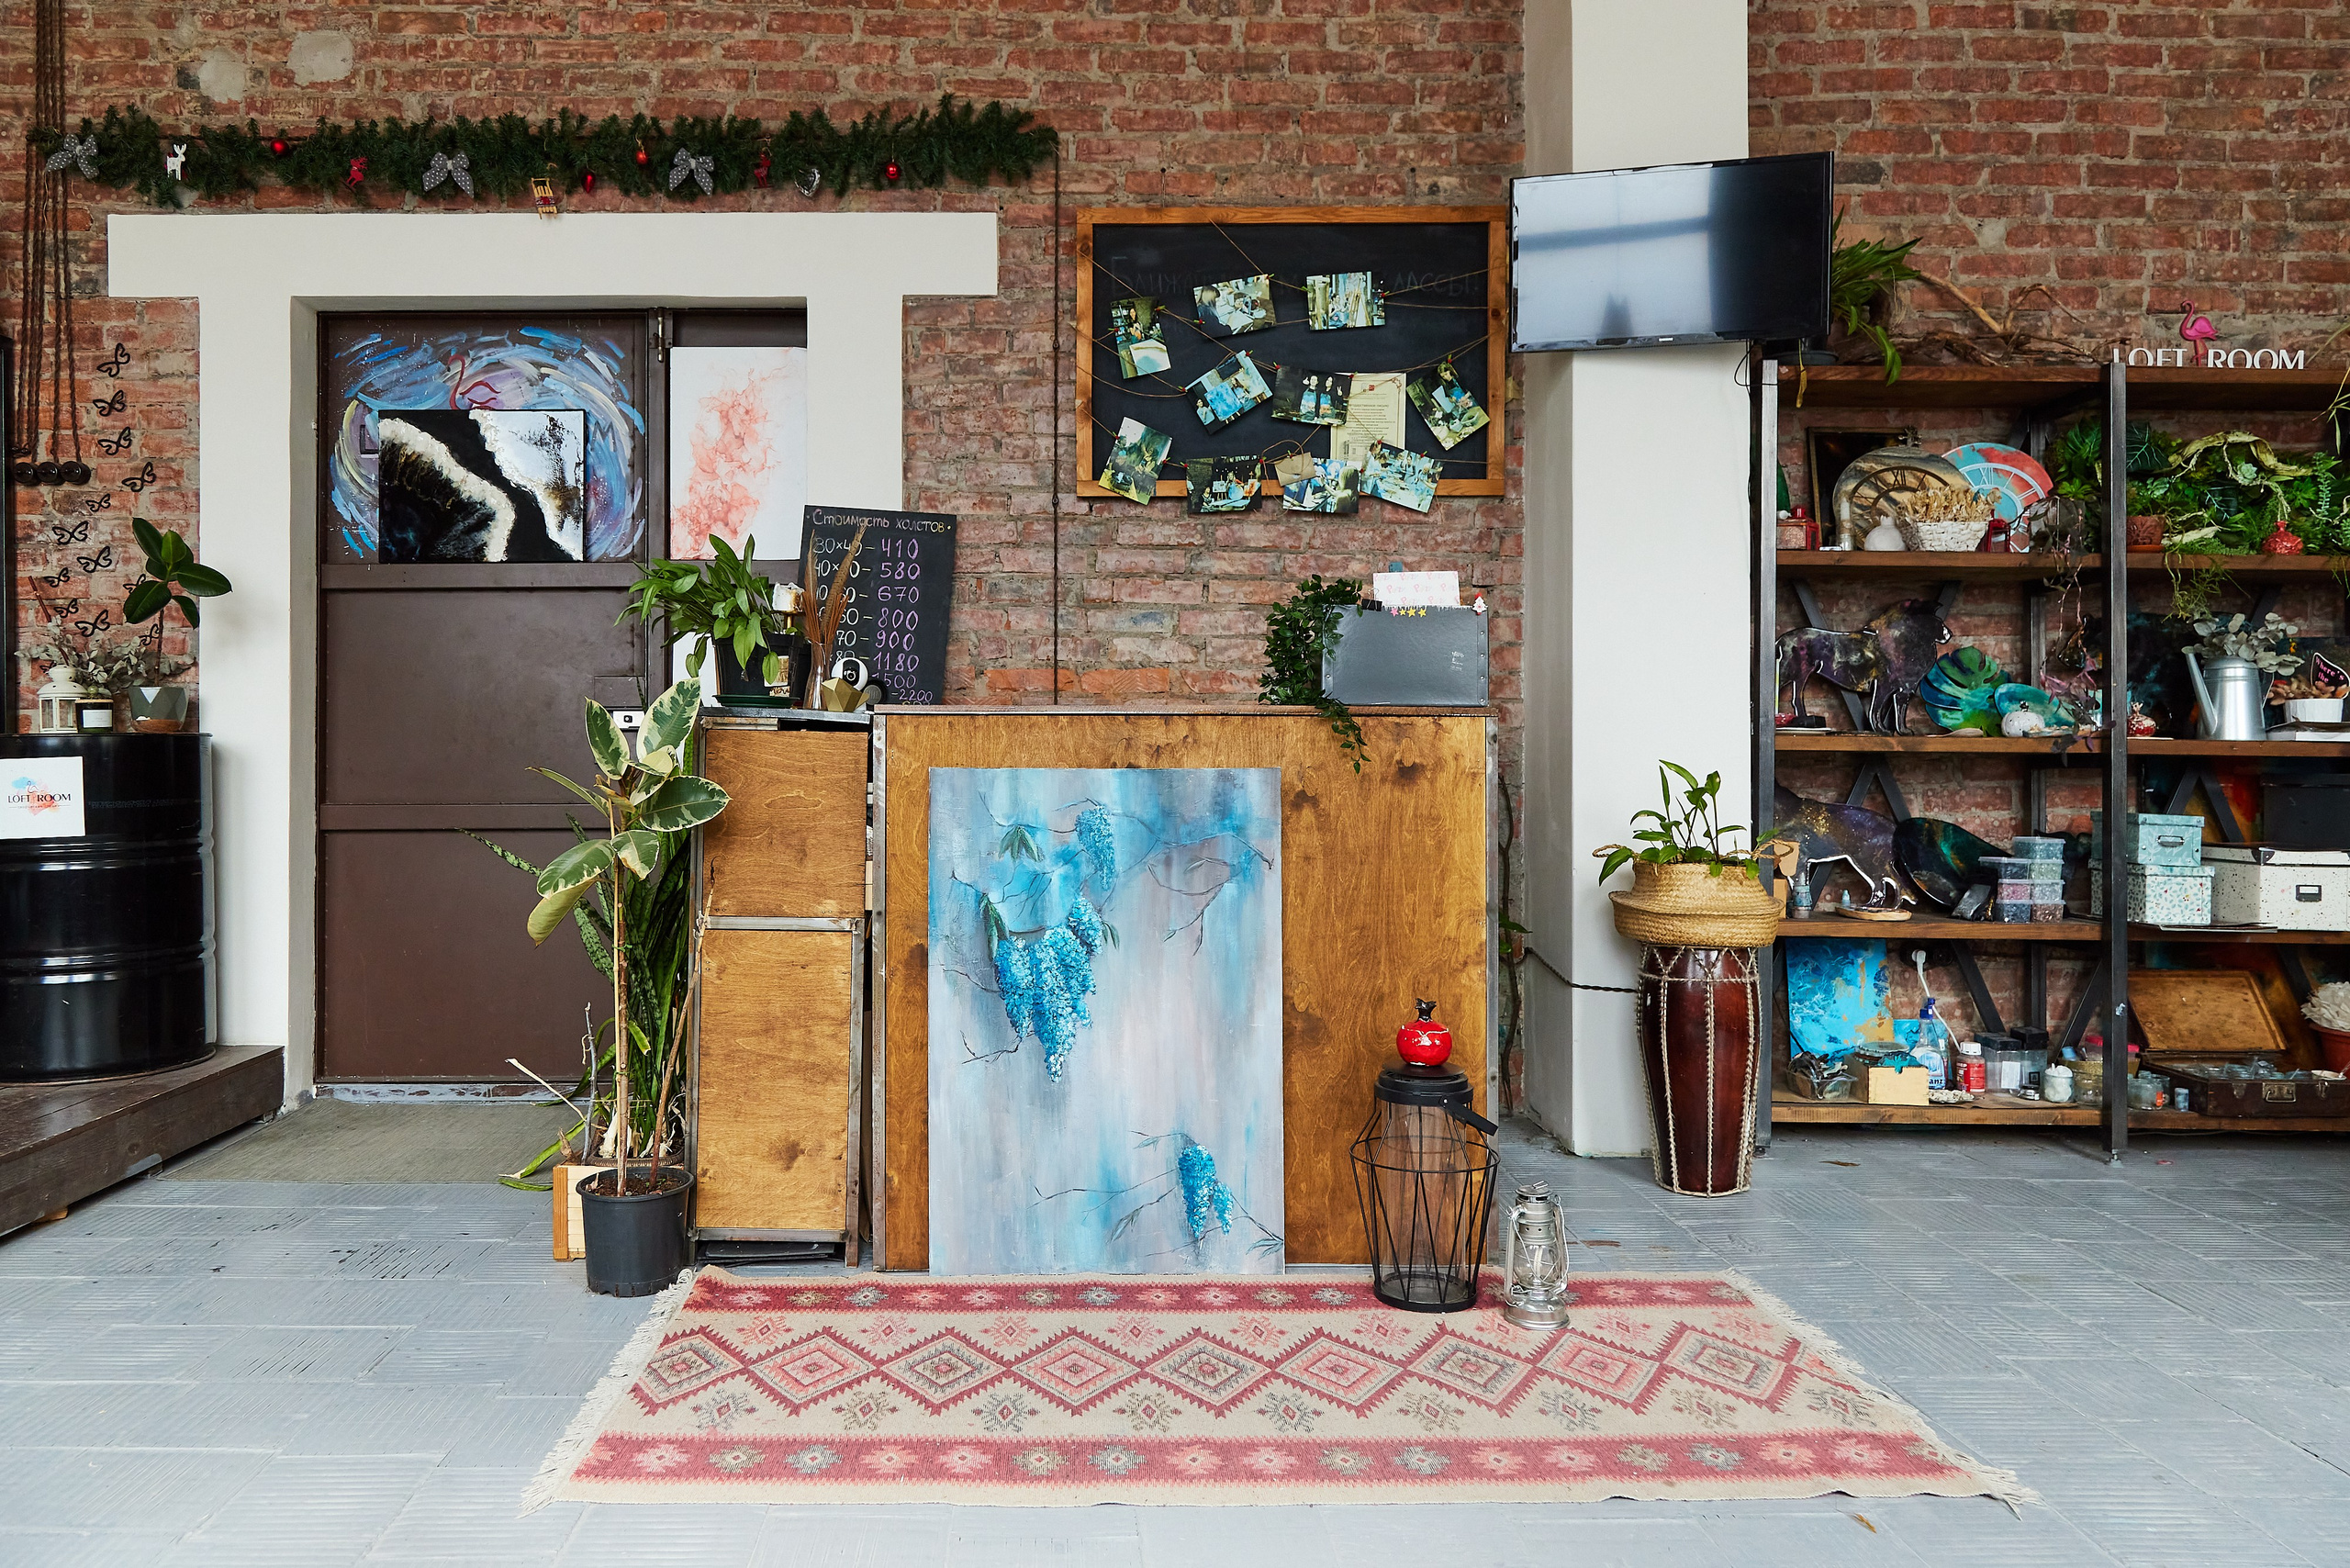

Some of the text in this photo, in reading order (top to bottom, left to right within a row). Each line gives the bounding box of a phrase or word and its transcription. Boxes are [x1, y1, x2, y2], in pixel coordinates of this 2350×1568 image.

[2207, 348, 2305, 369] ROOM
[812, 508, 946, 533] Стоимость холстов
[881, 538, 919, 560] 410
[879, 561, 921, 580] 580
[877, 585, 920, 604] 670
[878, 607, 919, 632] 800
[875, 629, 915, 652] 900
[873, 651, 920, 673] 1180
[2315, 655, 2344, 680] Where's
[2318, 671, 2329, 683] the
[7, 793, 72, 803] LOFT ROOM
